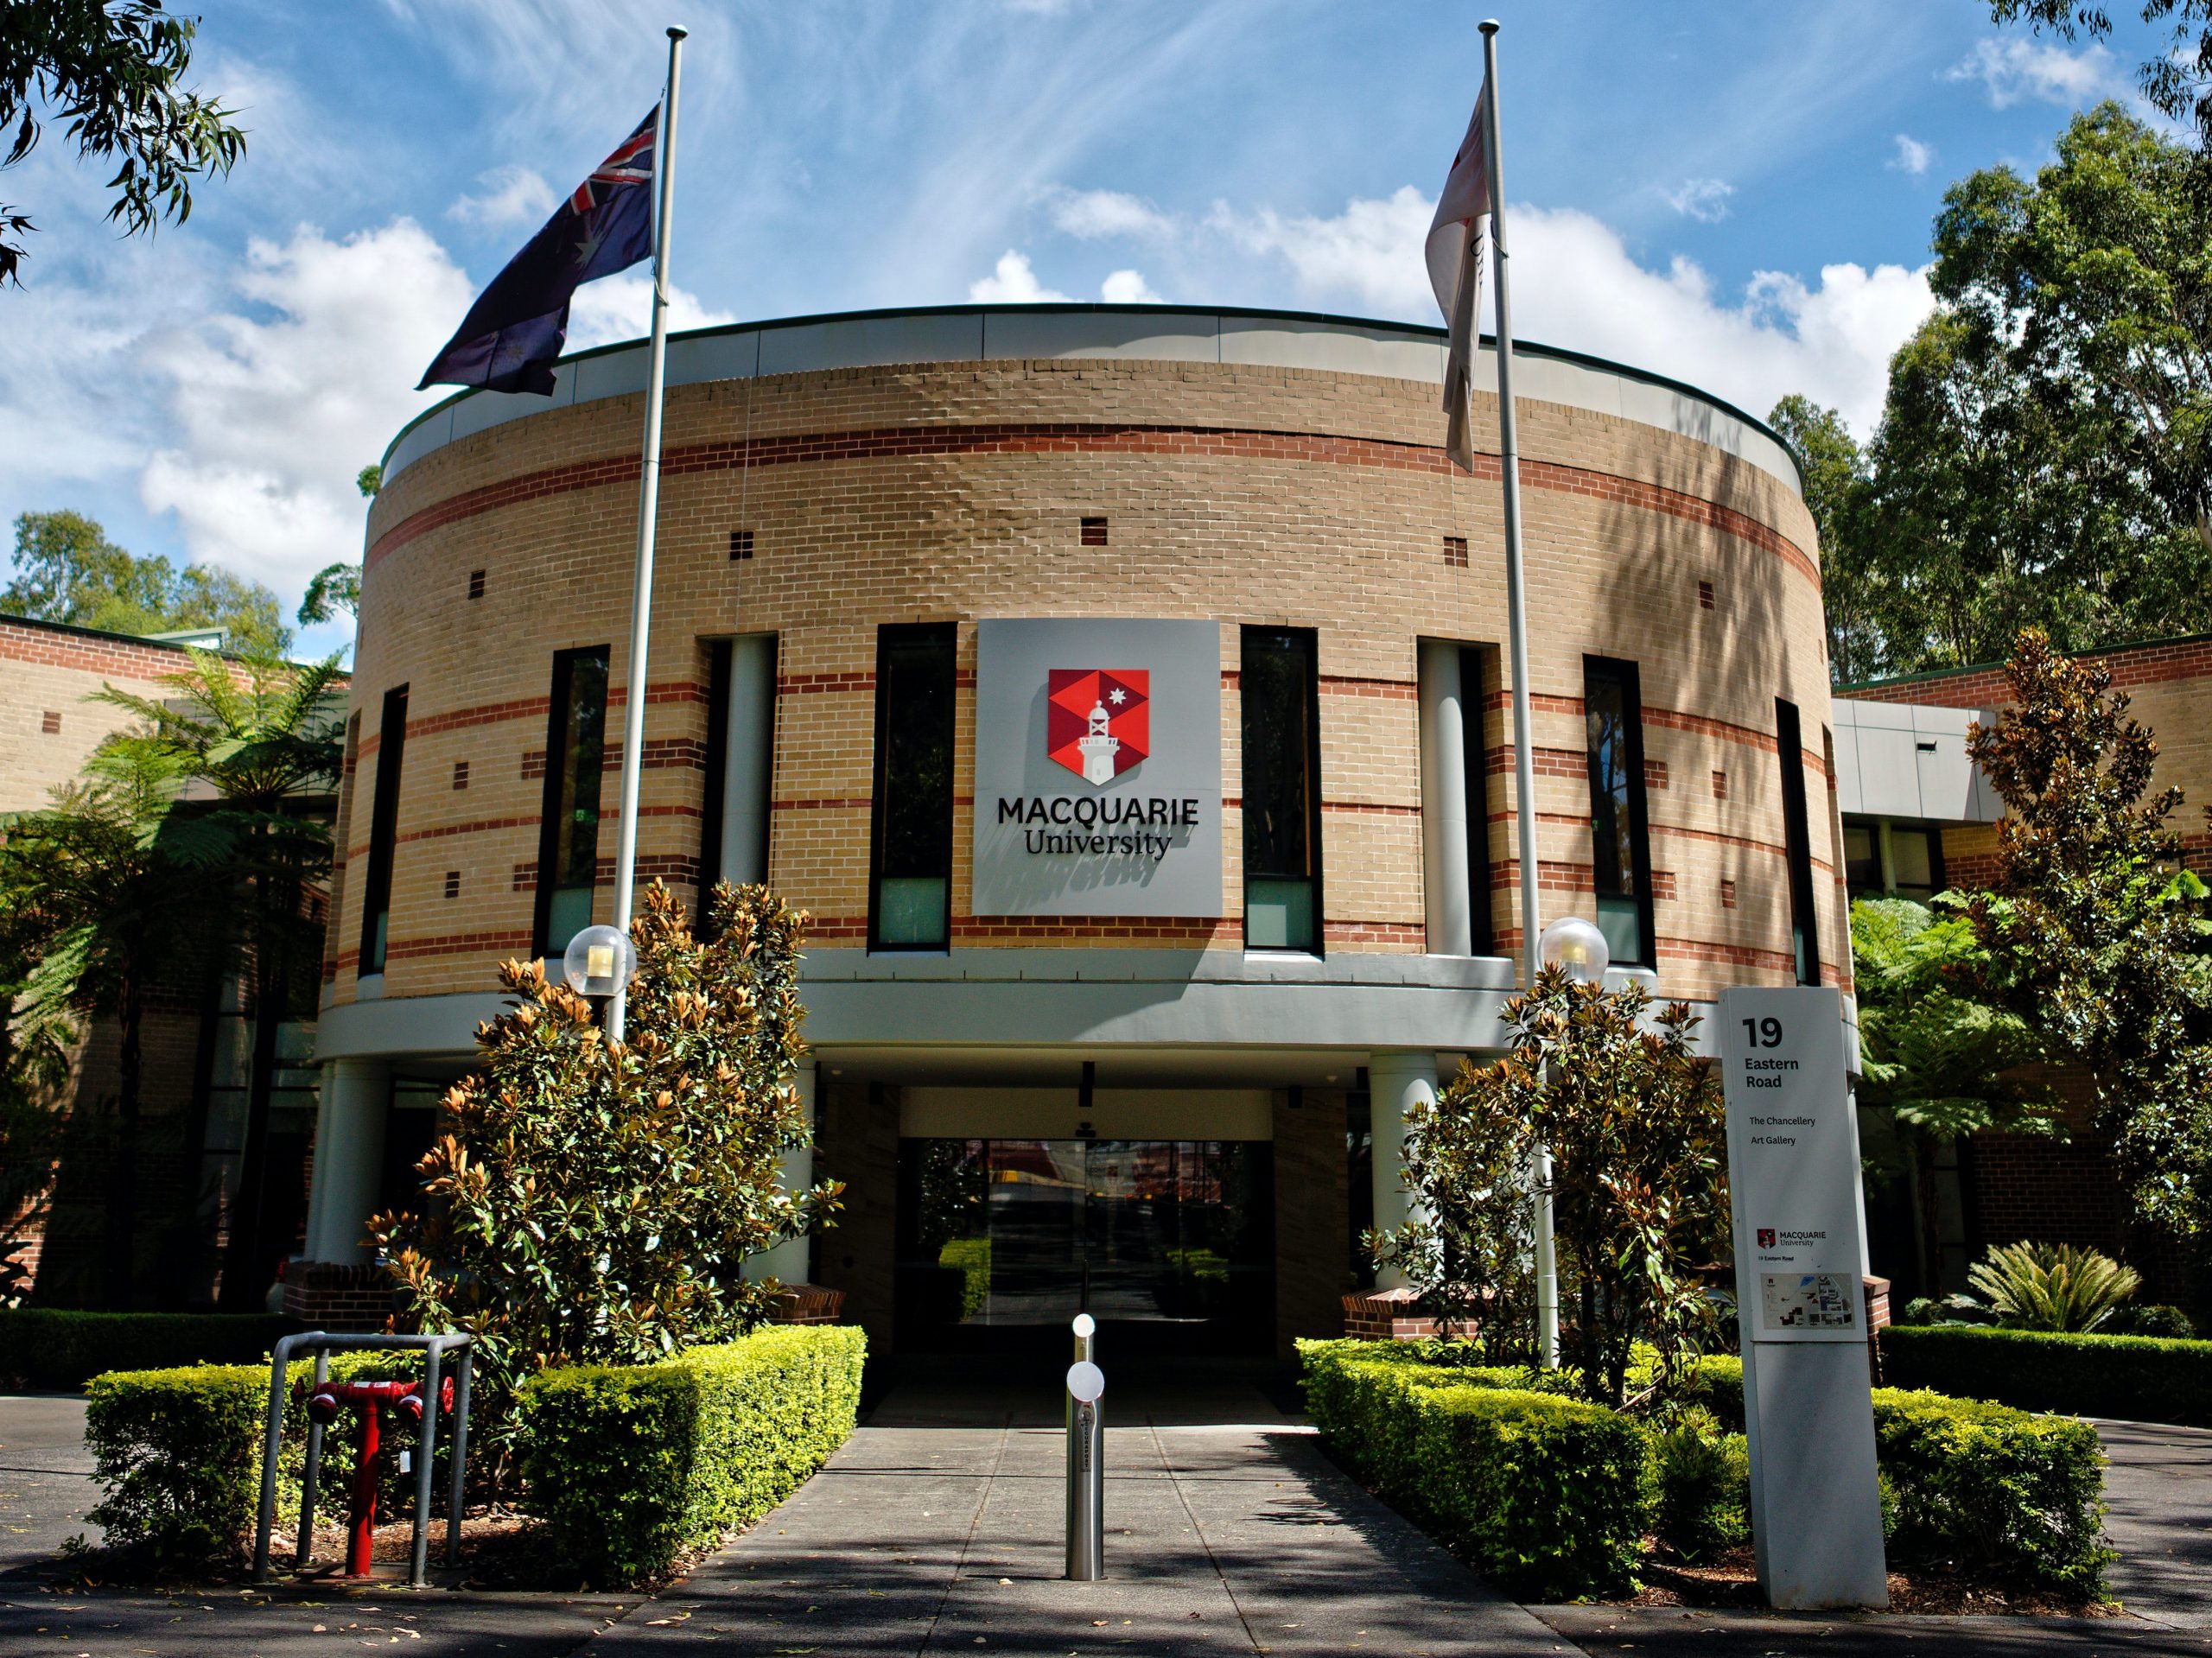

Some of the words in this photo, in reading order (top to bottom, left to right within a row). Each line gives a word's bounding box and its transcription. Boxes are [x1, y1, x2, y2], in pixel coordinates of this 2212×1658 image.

[998, 797, 1198, 829] MACQUARIE
[1024, 829, 1173, 861] University
[1742, 1017, 1783, 1048] 19
[1745, 1058, 1799, 1070] Eastern
[1746, 1075, 1782, 1088] Road
[1749, 1116, 1764, 1125] The
[1766, 1116, 1816, 1128] Chancellery
[1751, 1135, 1764, 1145] Art
[1766, 1135, 1796, 1147] Gallery
[1779, 1231, 1827, 1240] MACQUARIE
[1780, 1239, 1815, 1248] University
